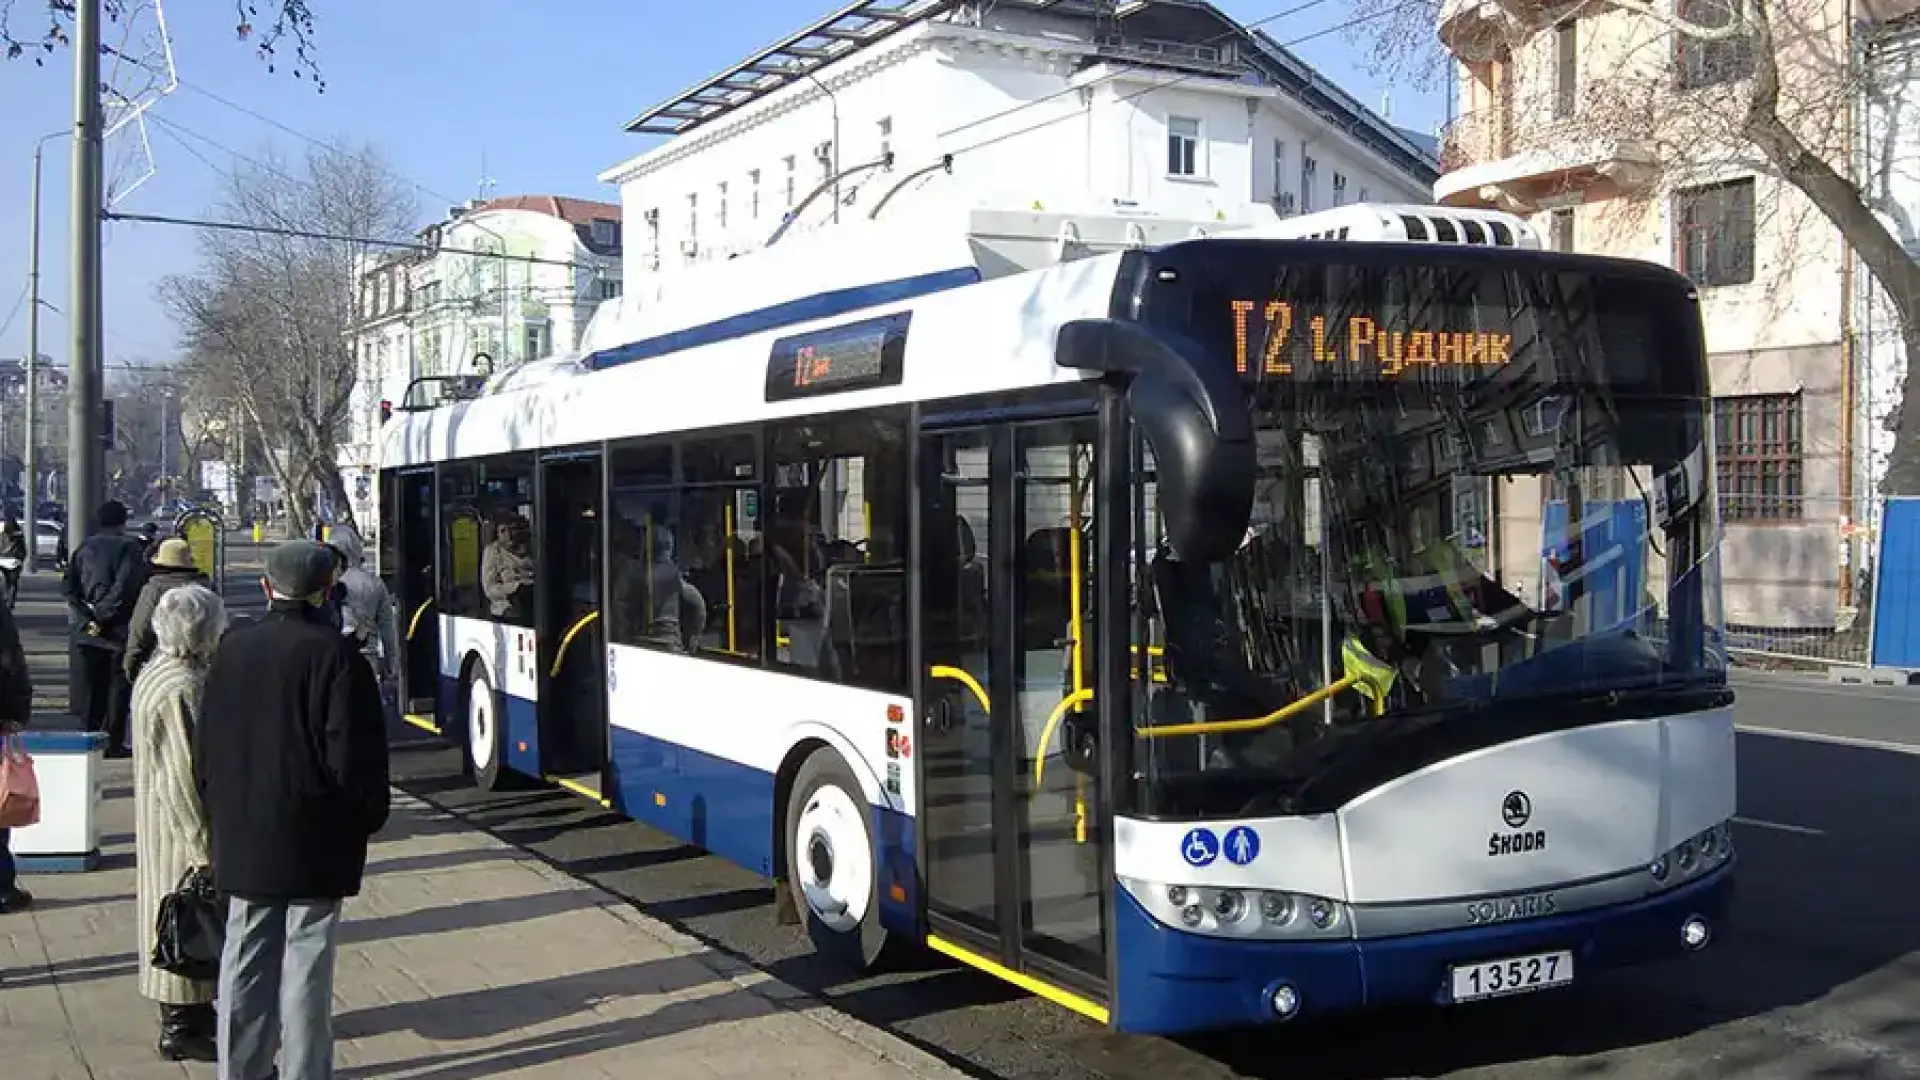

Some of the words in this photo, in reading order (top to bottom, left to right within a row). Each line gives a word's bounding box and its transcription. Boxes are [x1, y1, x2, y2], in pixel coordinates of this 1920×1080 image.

[1349, 316, 1511, 375] Рудник
[1488, 829, 1546, 857] ŠKODA
[1466, 893, 1556, 924] SOLARIS
[1468, 955, 1561, 994] 13527
